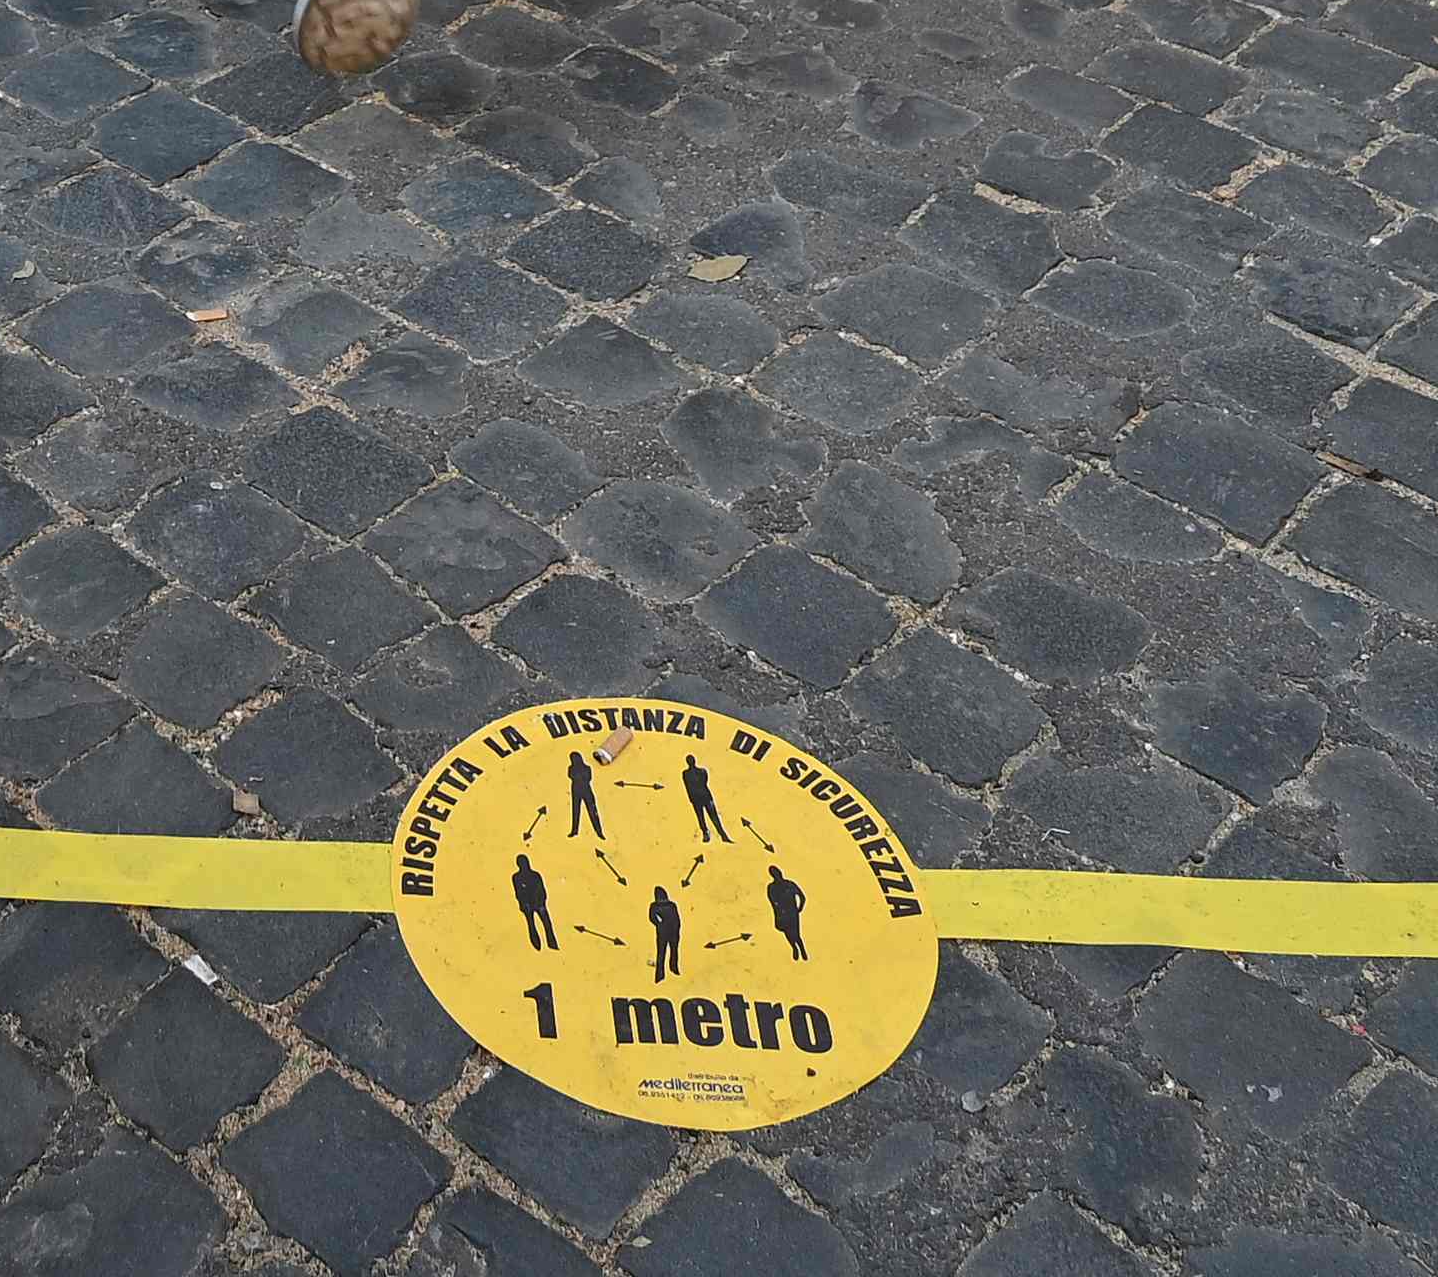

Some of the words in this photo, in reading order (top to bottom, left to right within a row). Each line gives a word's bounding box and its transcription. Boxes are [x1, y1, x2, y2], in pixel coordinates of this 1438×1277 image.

[401, 757, 484, 896] RISPETTA
[483, 725, 531, 758] LA
[542, 707, 705, 739] DISTANZA
[730, 730, 772, 762] DI
[779, 757, 923, 919] SICUREZZA
[523, 982, 558, 1039] 1
[612, 991, 834, 1054] metro
